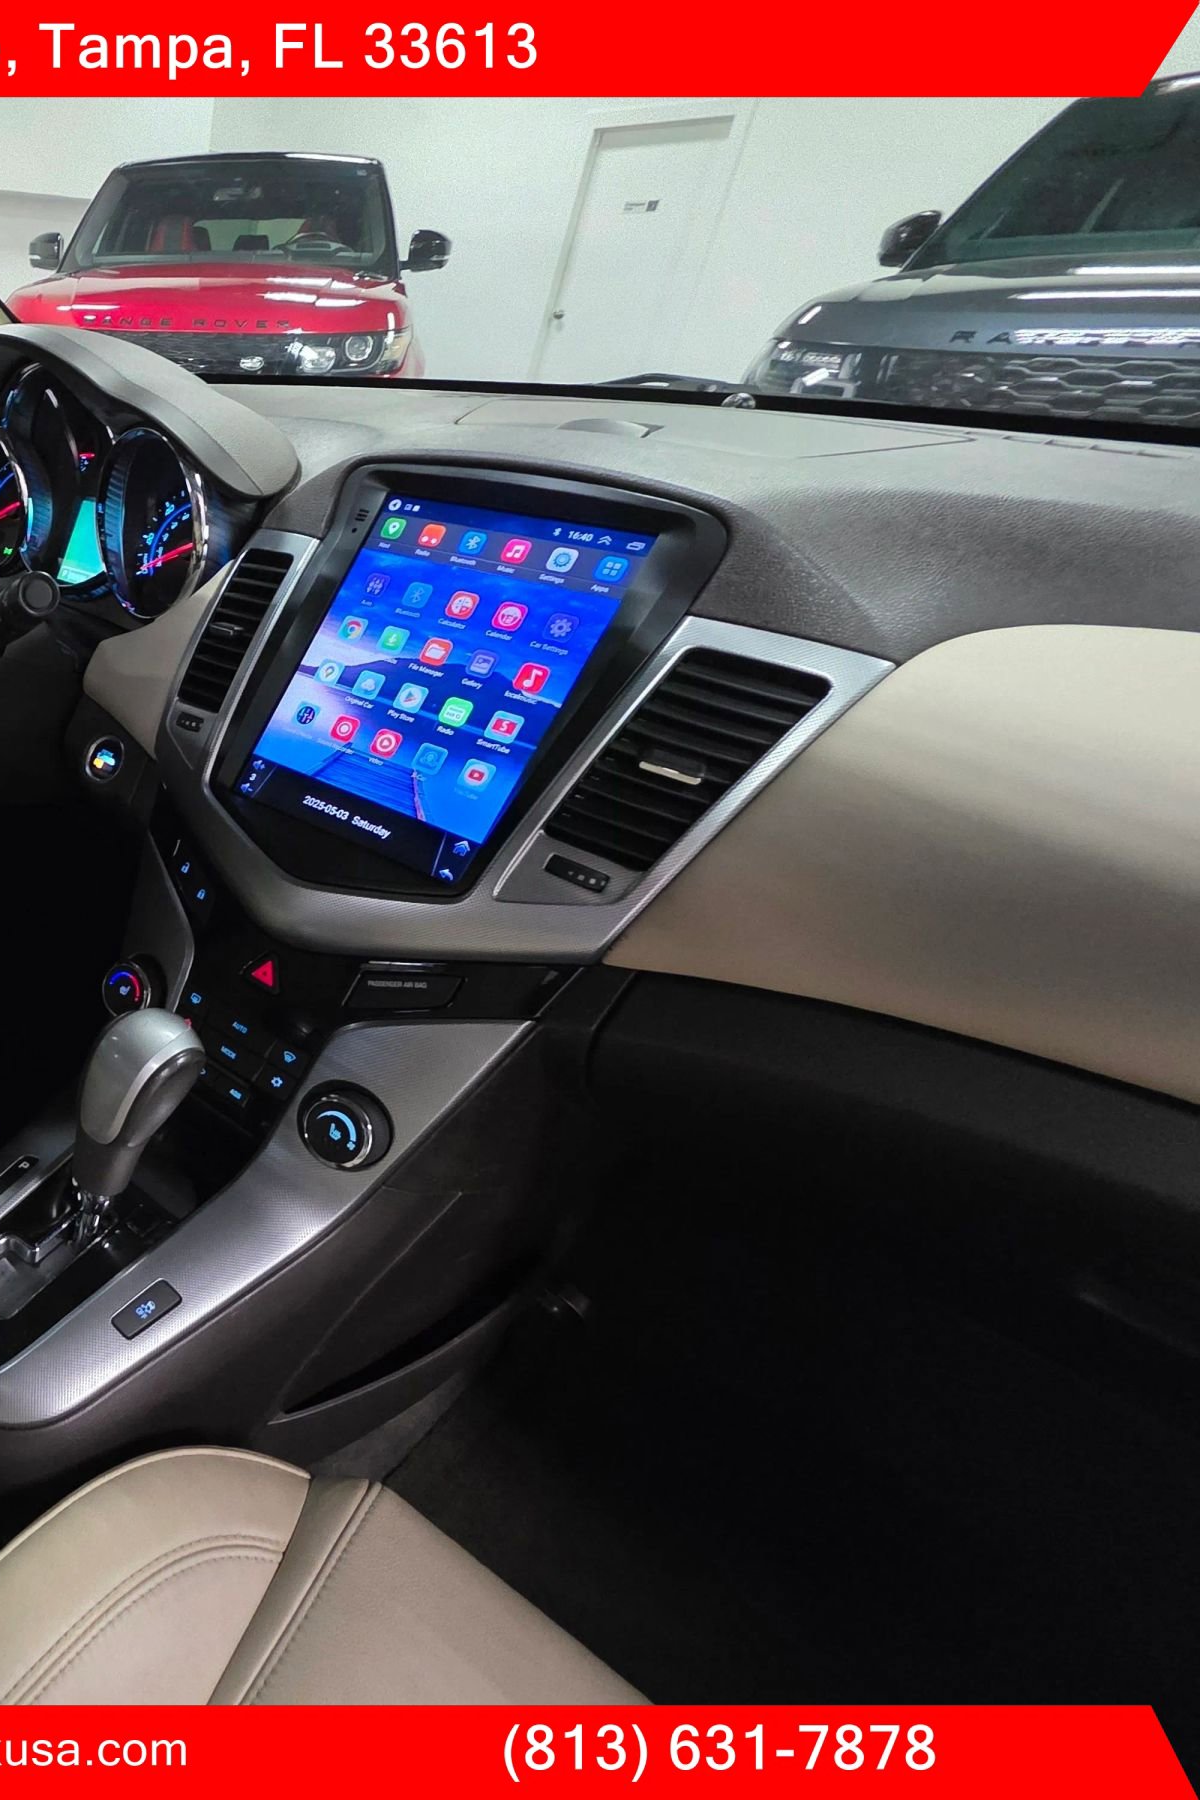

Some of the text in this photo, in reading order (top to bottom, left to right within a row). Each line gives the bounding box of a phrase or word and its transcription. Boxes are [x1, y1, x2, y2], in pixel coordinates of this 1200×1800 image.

[567, 530, 594, 542] 16:40
[485, 629, 513, 641] Calendar
[302, 795, 391, 840] 2025-05-03 Saturday
